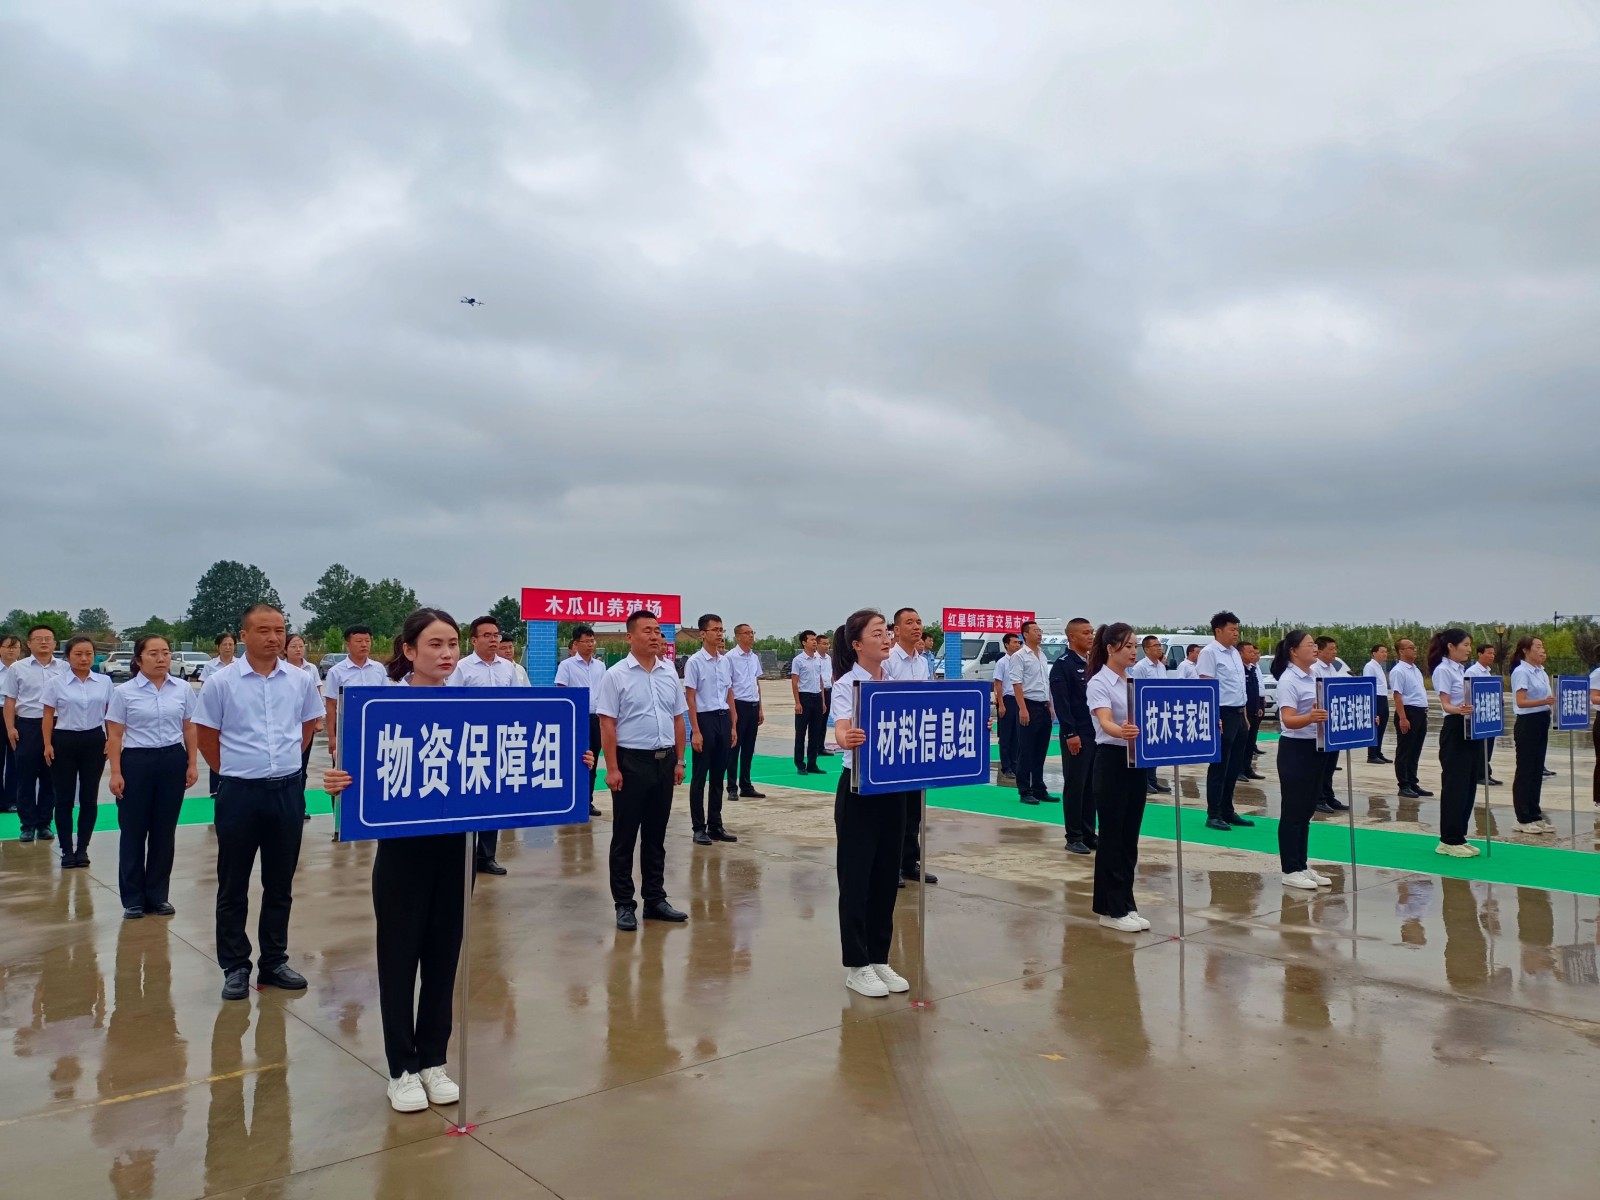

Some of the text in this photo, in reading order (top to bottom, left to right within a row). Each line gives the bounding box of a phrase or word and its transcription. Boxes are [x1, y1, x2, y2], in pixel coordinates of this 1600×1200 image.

[545, 595, 662, 619] 木瓜山养殖场
[877, 707, 976, 765] 材料信息组
[1145, 699, 1212, 745] 技术专家组
[1330, 694, 1372, 732] 疫区封锁组
[376, 720, 563, 801] 物资保障组
